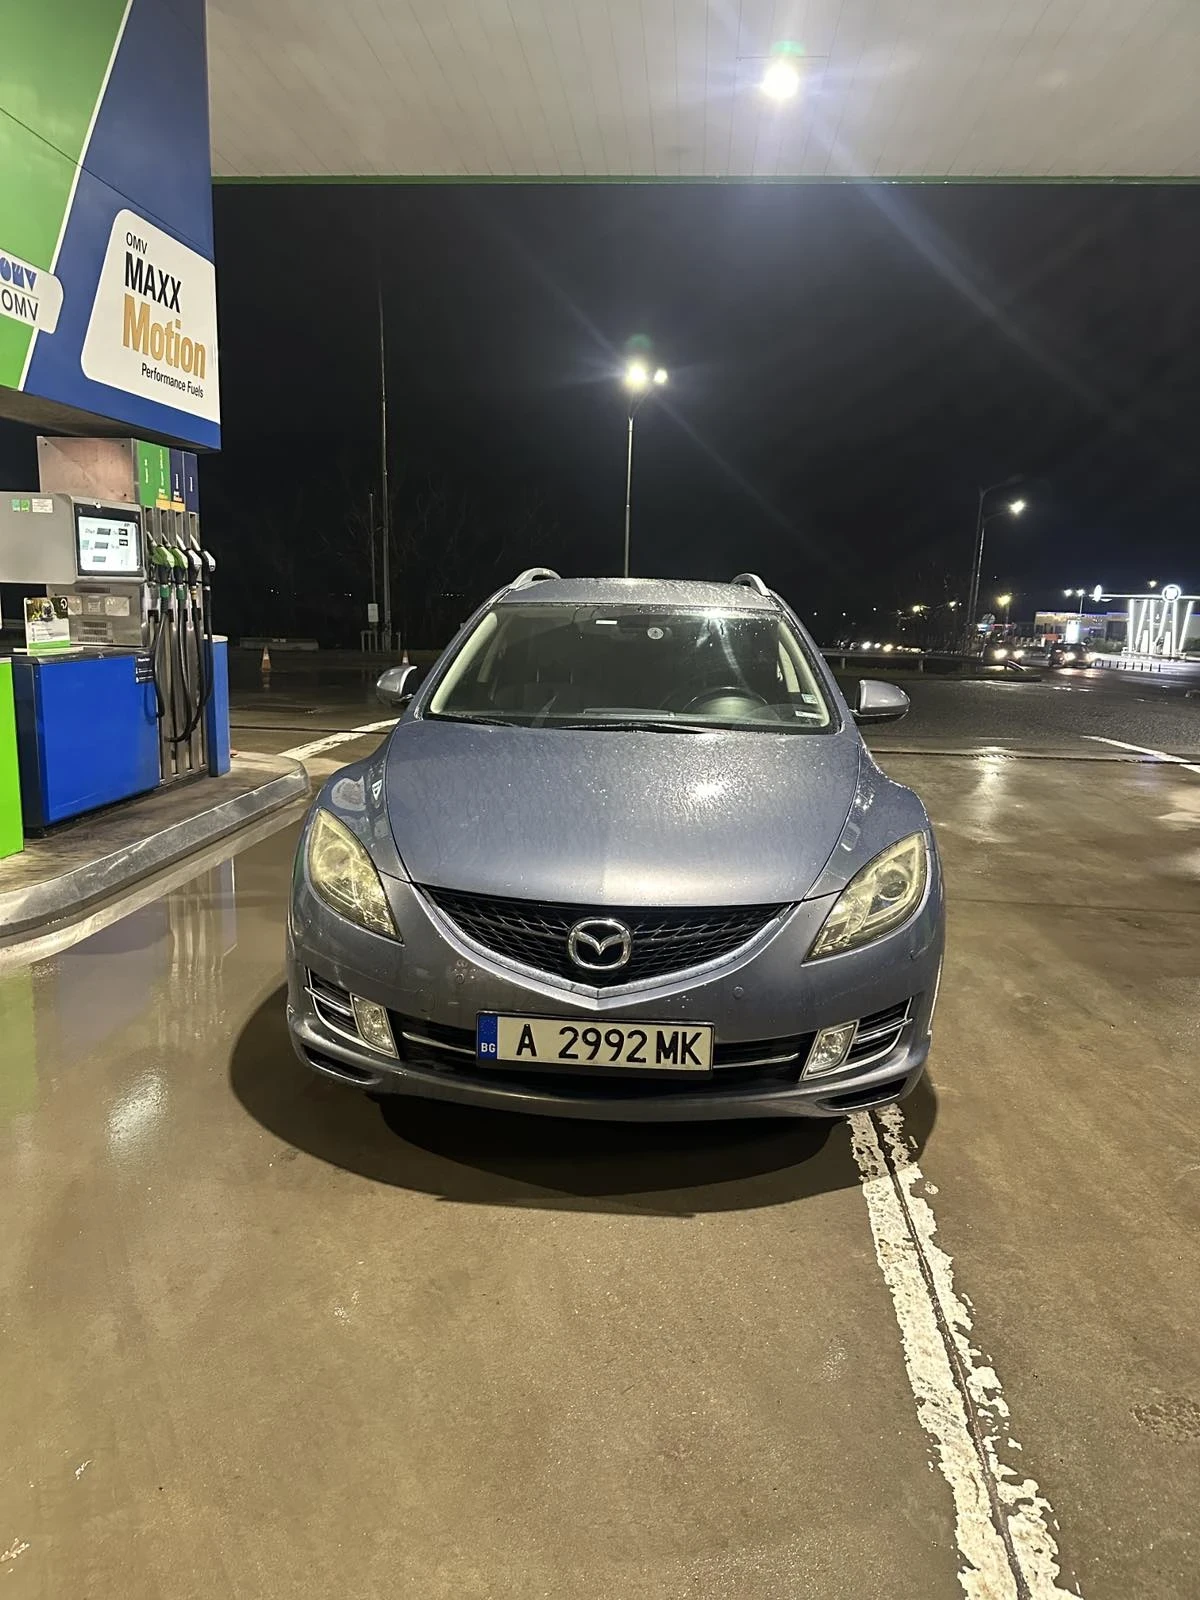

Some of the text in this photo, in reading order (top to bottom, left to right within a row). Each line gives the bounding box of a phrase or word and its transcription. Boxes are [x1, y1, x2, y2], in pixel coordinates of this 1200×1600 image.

[126, 231, 148, 254] OMV
[124, 251, 182, 313] MAXX
[1, 289, 39, 321] OMV
[122, 293, 206, 379] Motion
[141, 362, 204, 399] Performance Fuels
[481, 1042, 496, 1053] BG
[516, 1023, 702, 1066] A 2992 MK
